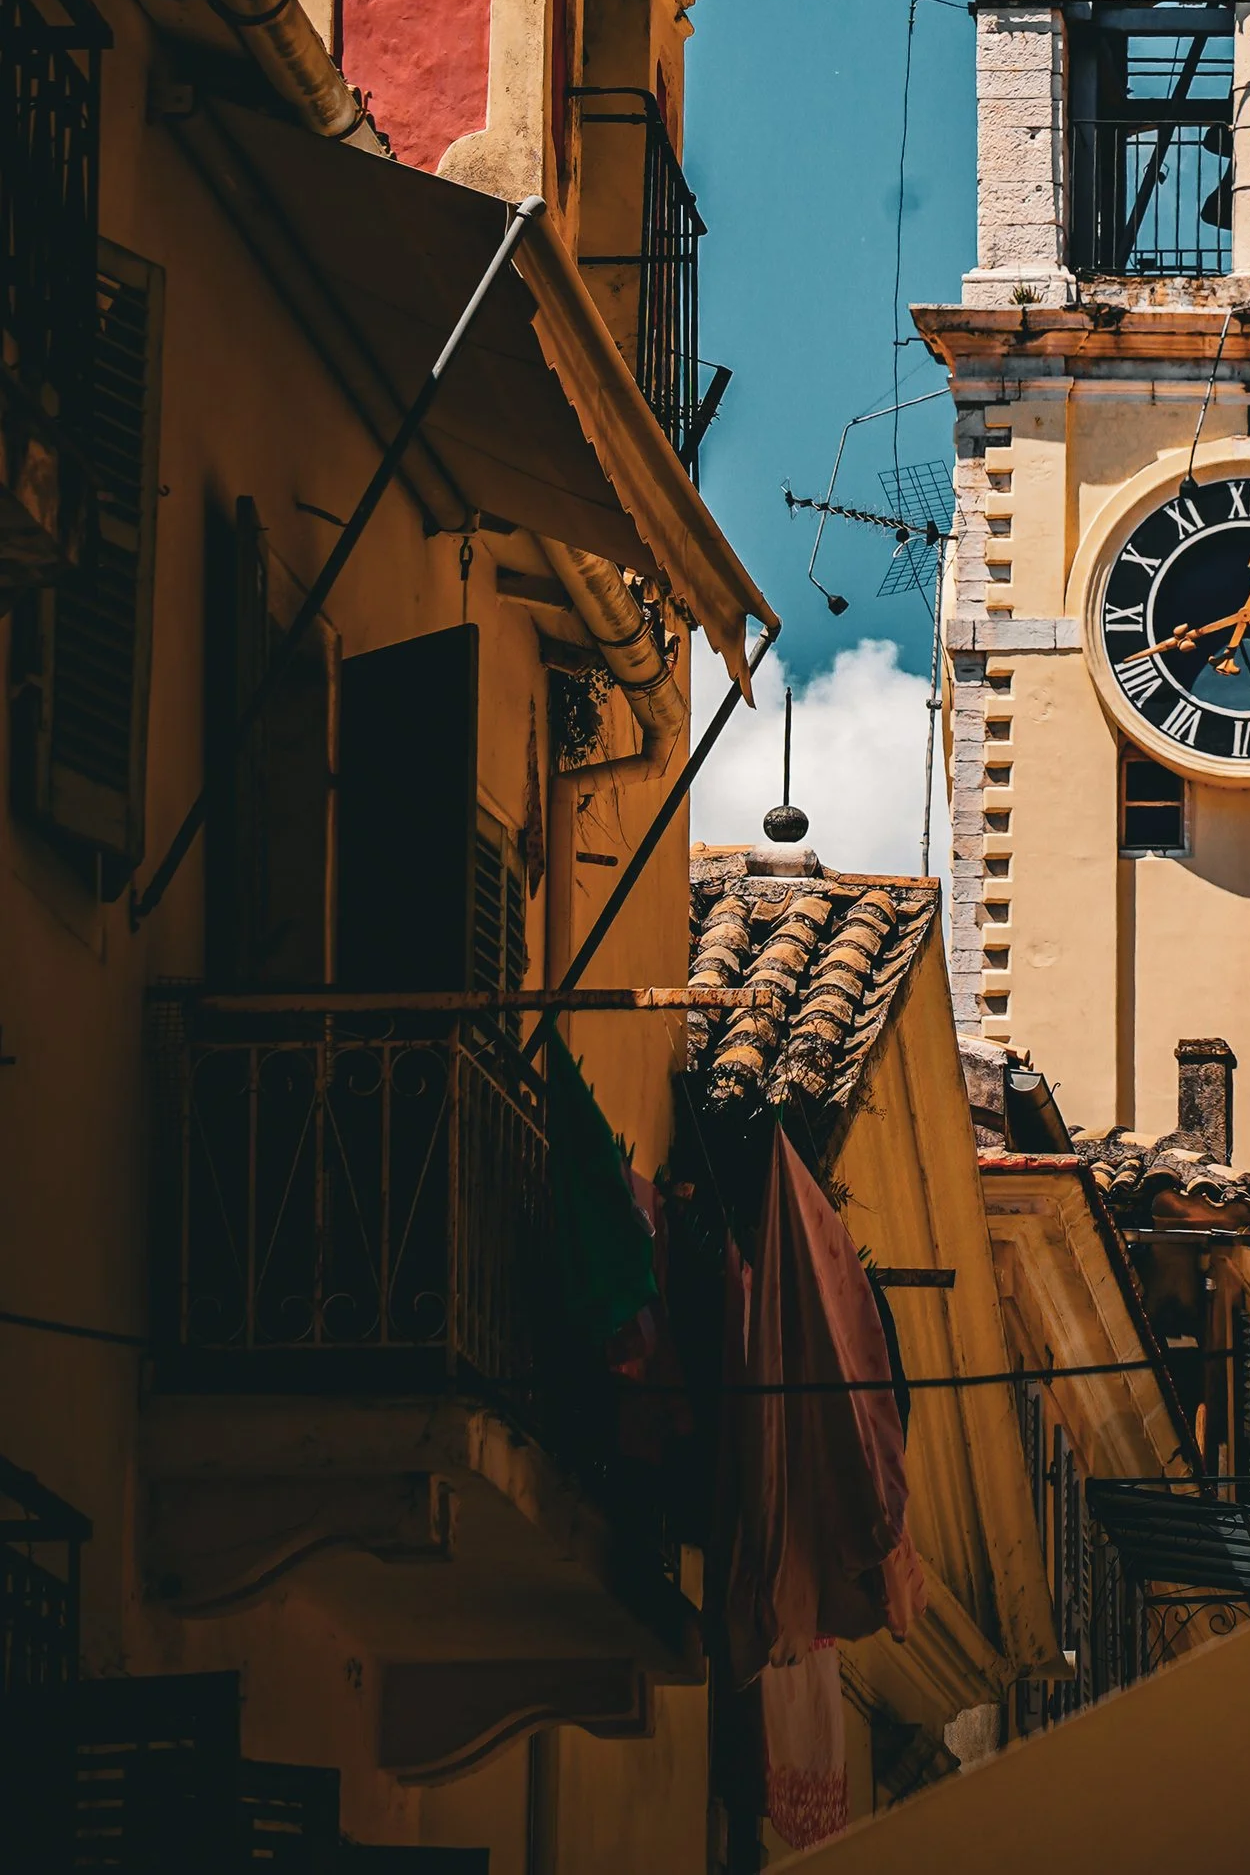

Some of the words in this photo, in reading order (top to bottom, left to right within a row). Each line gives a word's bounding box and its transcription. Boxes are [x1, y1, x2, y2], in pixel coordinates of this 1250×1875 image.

[1163, 498, 1205, 540] XI
[1121, 543, 1161, 577] X
[1105, 602, 1143, 632] IX
[1114, 656, 1163, 708] VIII
[1160, 698, 1202, 746] VII
